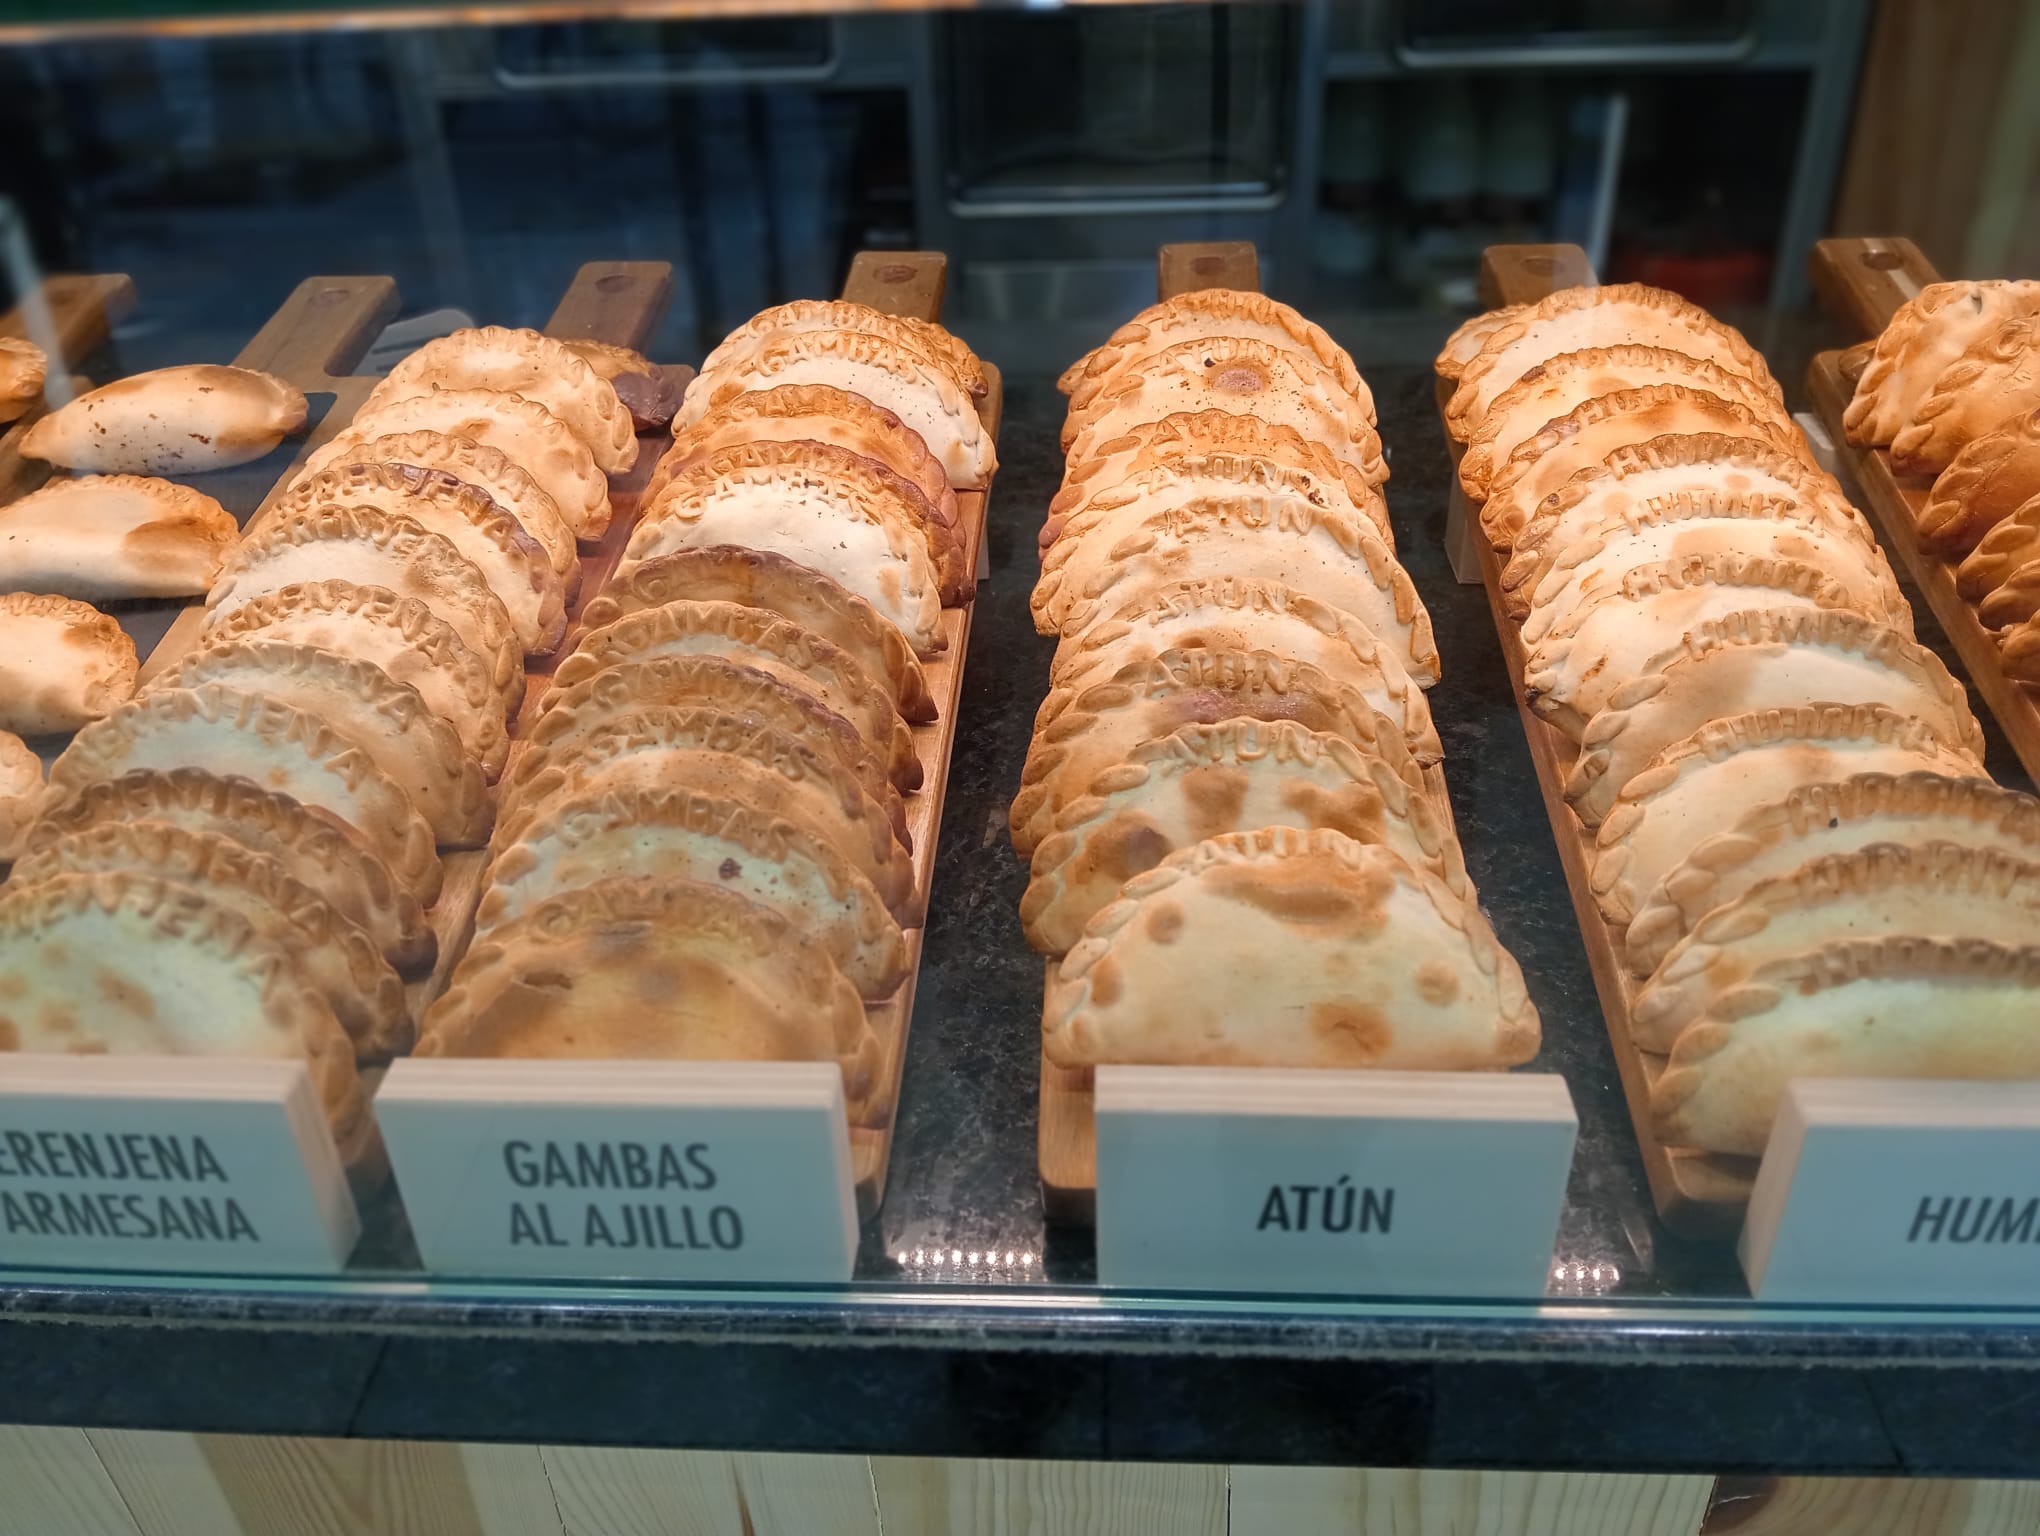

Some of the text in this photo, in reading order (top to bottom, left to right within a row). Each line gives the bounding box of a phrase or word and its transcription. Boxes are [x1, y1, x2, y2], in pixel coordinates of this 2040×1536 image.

[503, 1140, 717, 1191] GAMBAS
[2, 1191, 260, 1242] ARMESANA
[510, 1202, 744, 1250] AL AJILLO
[1256, 1174, 1395, 1234] ATÚN
[1906, 1196, 2040, 1243] HUM
